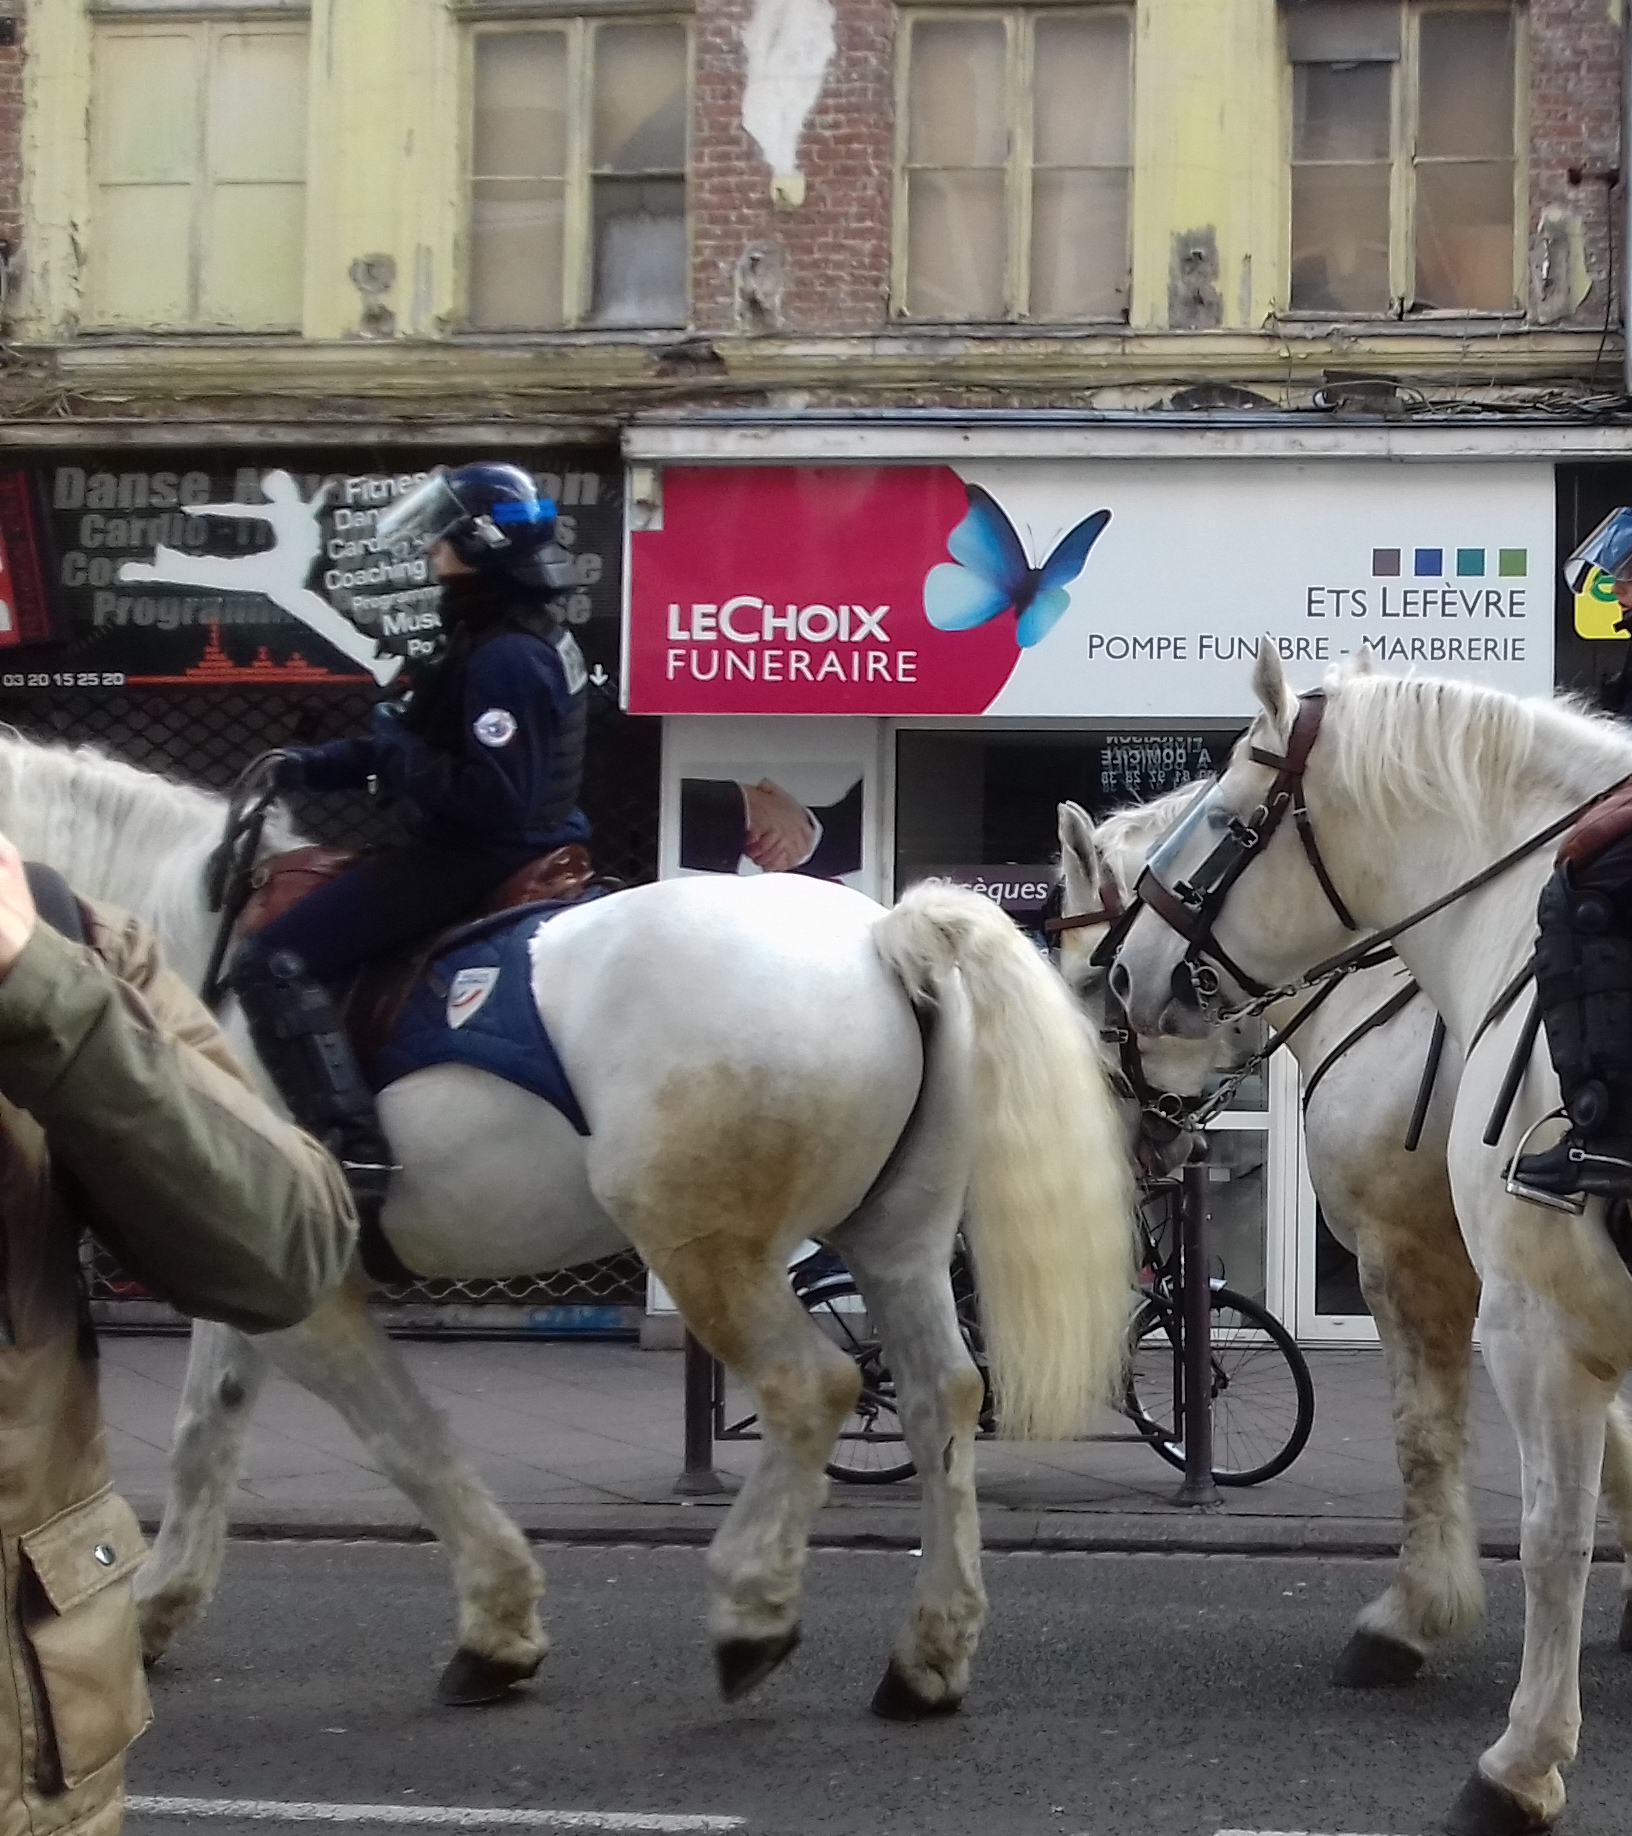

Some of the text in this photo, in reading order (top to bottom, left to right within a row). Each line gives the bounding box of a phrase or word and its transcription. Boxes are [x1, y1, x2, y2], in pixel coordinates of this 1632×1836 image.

[54, 467, 211, 509] Danse
[325, 556, 428, 590] Coaching
[1381, 582, 1526, 618] LEFÈVRE
[1088, 634, 1187, 660] POMPE
[1199, 631, 1330, 660] FUNBRE
[1361, 635, 1526, 660] MARBRERIE
[3, 673, 125, 686] 03 20 15 25 20
[666, 649, 917, 682] FUNERAIRE
